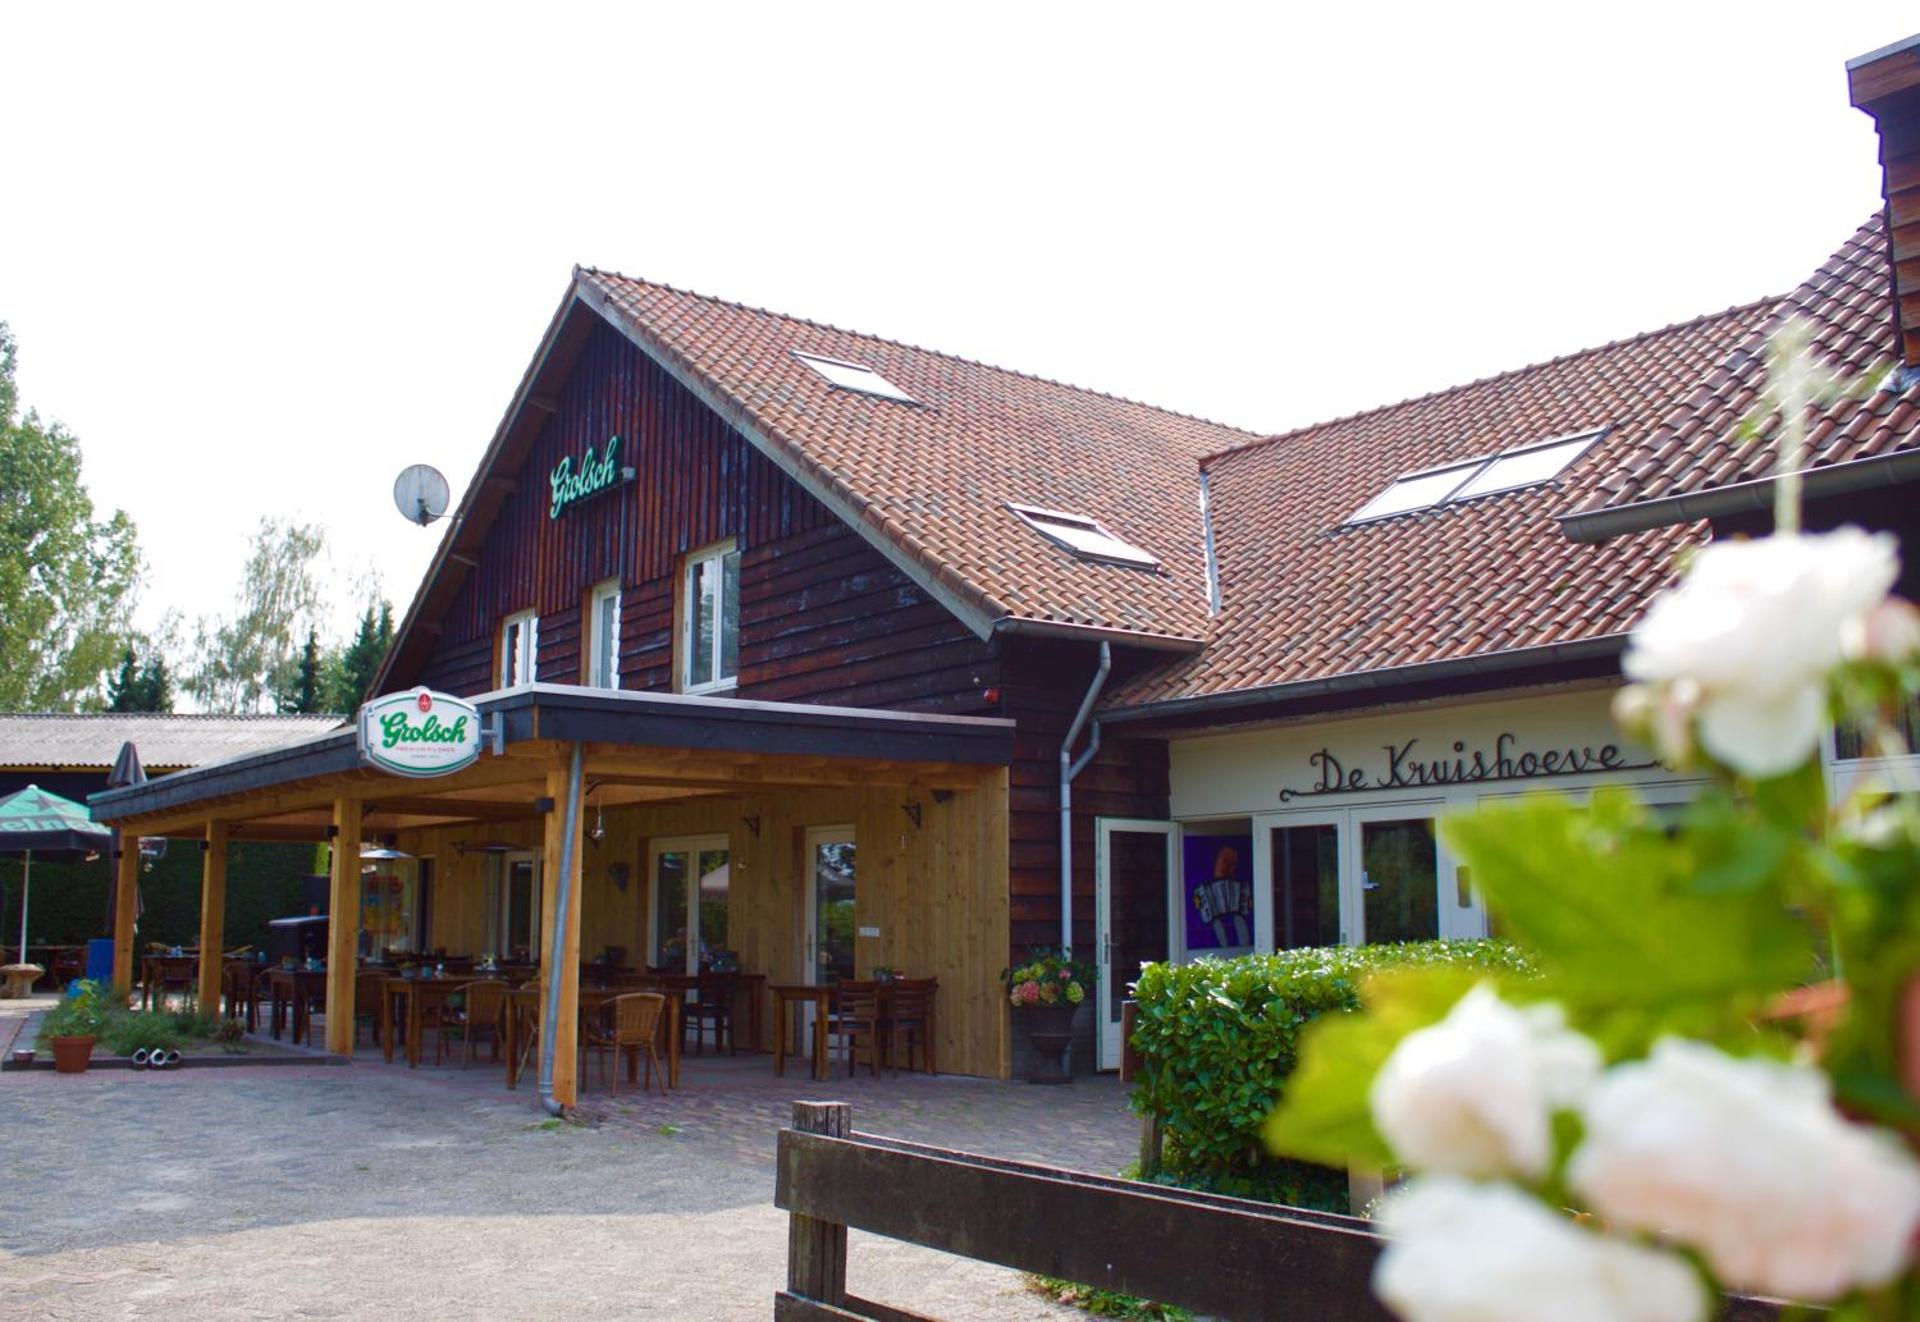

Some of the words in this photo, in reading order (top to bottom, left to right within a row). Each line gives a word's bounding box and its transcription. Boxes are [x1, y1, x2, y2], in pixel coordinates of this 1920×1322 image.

[550, 435, 617, 519] Grolsch
[379, 711, 468, 748] Grolsch
[1310, 747, 1369, 793] De
[1376, 733, 1625, 788] Kruishoeve
